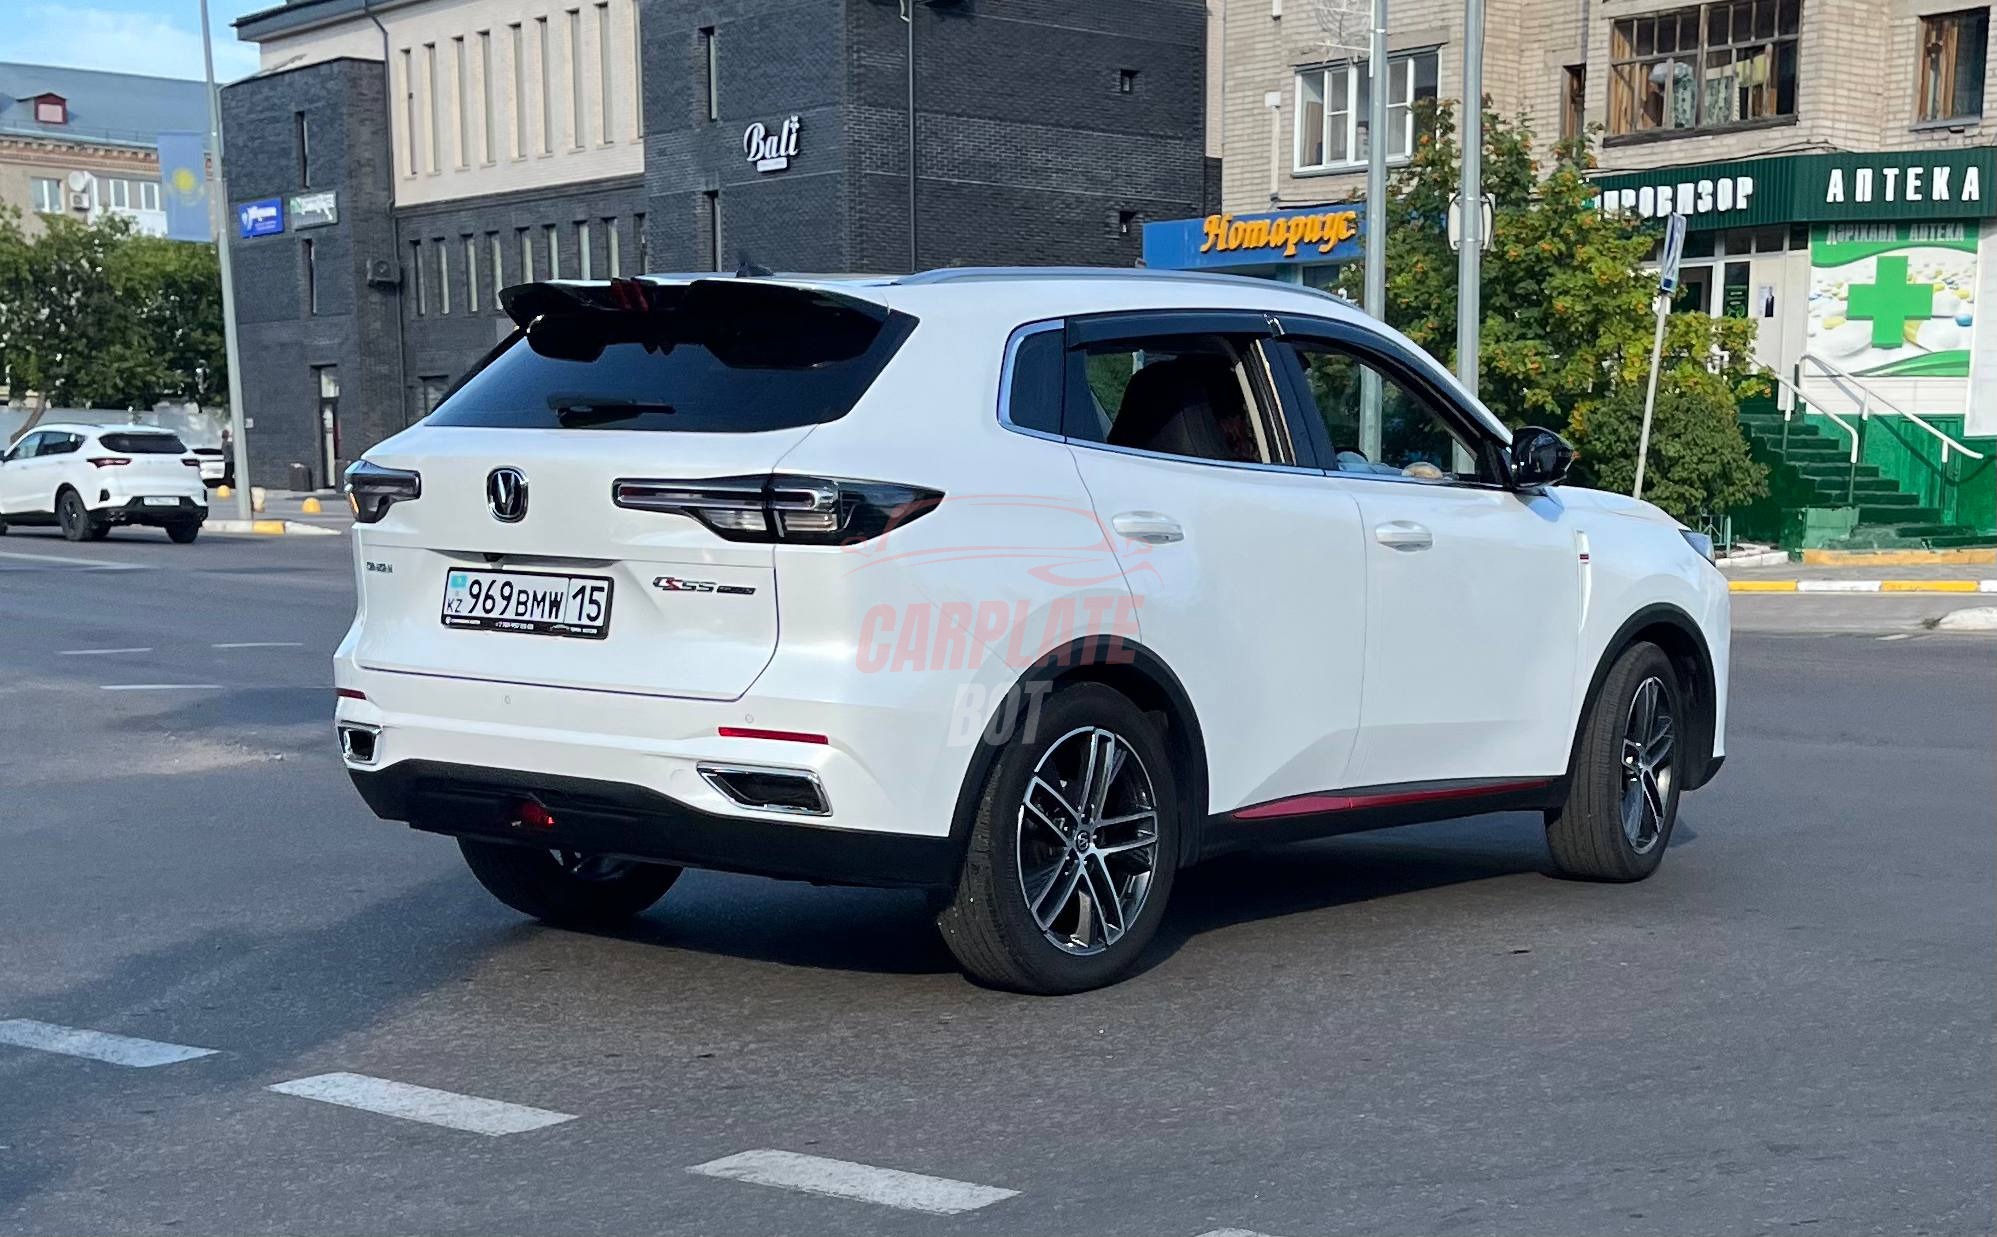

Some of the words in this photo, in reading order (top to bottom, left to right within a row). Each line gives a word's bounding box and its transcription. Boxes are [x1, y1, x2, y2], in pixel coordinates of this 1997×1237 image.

[743, 114, 800, 162] Bali
[1826, 166, 1980, 203] АПТЕКА
[1200, 210, 1357, 257] Нотариус
[1909, 222, 1965, 242] АПТЕКА
[446, 598, 463, 613] KZ
[572, 585, 605, 622] 15
